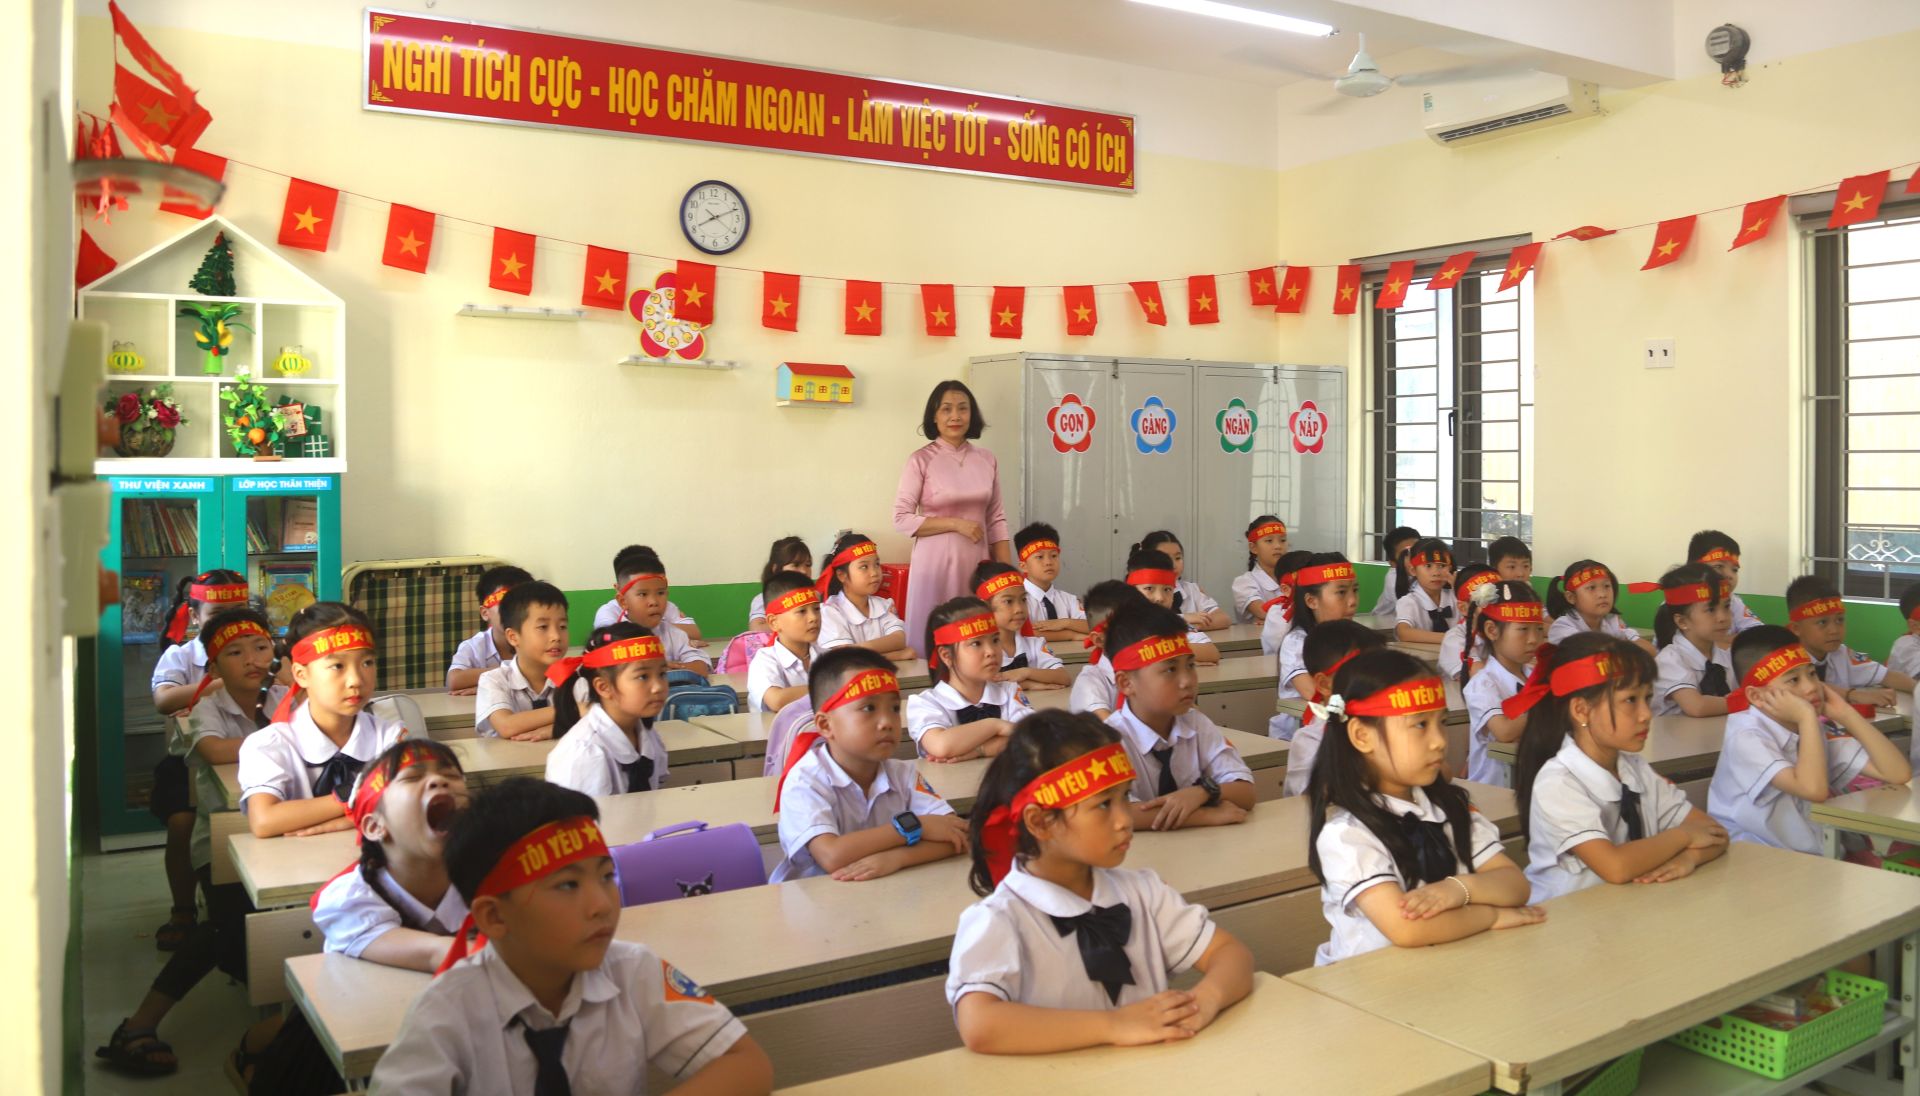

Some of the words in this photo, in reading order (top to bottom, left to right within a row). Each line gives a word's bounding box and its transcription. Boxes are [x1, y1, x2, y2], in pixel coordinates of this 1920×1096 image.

[383, 35, 454, 95] NGHĨ
[460, 39, 521, 103] TÍCH
[529, 56, 582, 117] CỰC
[608, 66, 659, 126] HỌC
[667, 68, 737, 127] CHĂM
[745, 84, 825, 138] NGOAN
[847, 89, 893, 145] LÀM
[899, 98, 946, 160] VIỆC
[952, 102, 988, 157] TỐT
[1007, 109, 1060, 166] SỐNG
[1066, 124, 1089, 170] CÓ
[1096, 122, 1126, 174] ÍCH
[1060, 413, 1084, 438] GỌN
[119, 480, 142, 490] THƯ
[144, 479, 170, 491] VIỆN
[172, 480, 206, 490] XANH
[238, 479, 256, 489] LỚP
[257, 480, 278, 491] HỌC
[1334, 566, 1348, 577] YÊU
[1515, 605, 1530, 618] YÊU
[973, 618, 989, 632] YÊU
[611, 645, 628, 661] TÔI
[629, 642, 647, 657] YÊU
[1138, 644, 1156, 662] TÔI
[1155, 638, 1176, 656] YÊU
[1768, 655, 1787, 672] YÊU
[860, 674, 882, 691] YÊU
[1388, 688, 1411, 709] TÔI
[1411, 685, 1435, 706] YÊU
[1033, 780, 1060, 806] TÔI
[1056, 769, 1088, 798] YÊU
[517, 843, 549, 876] TÔI
[547, 828, 583, 859] YÊU
